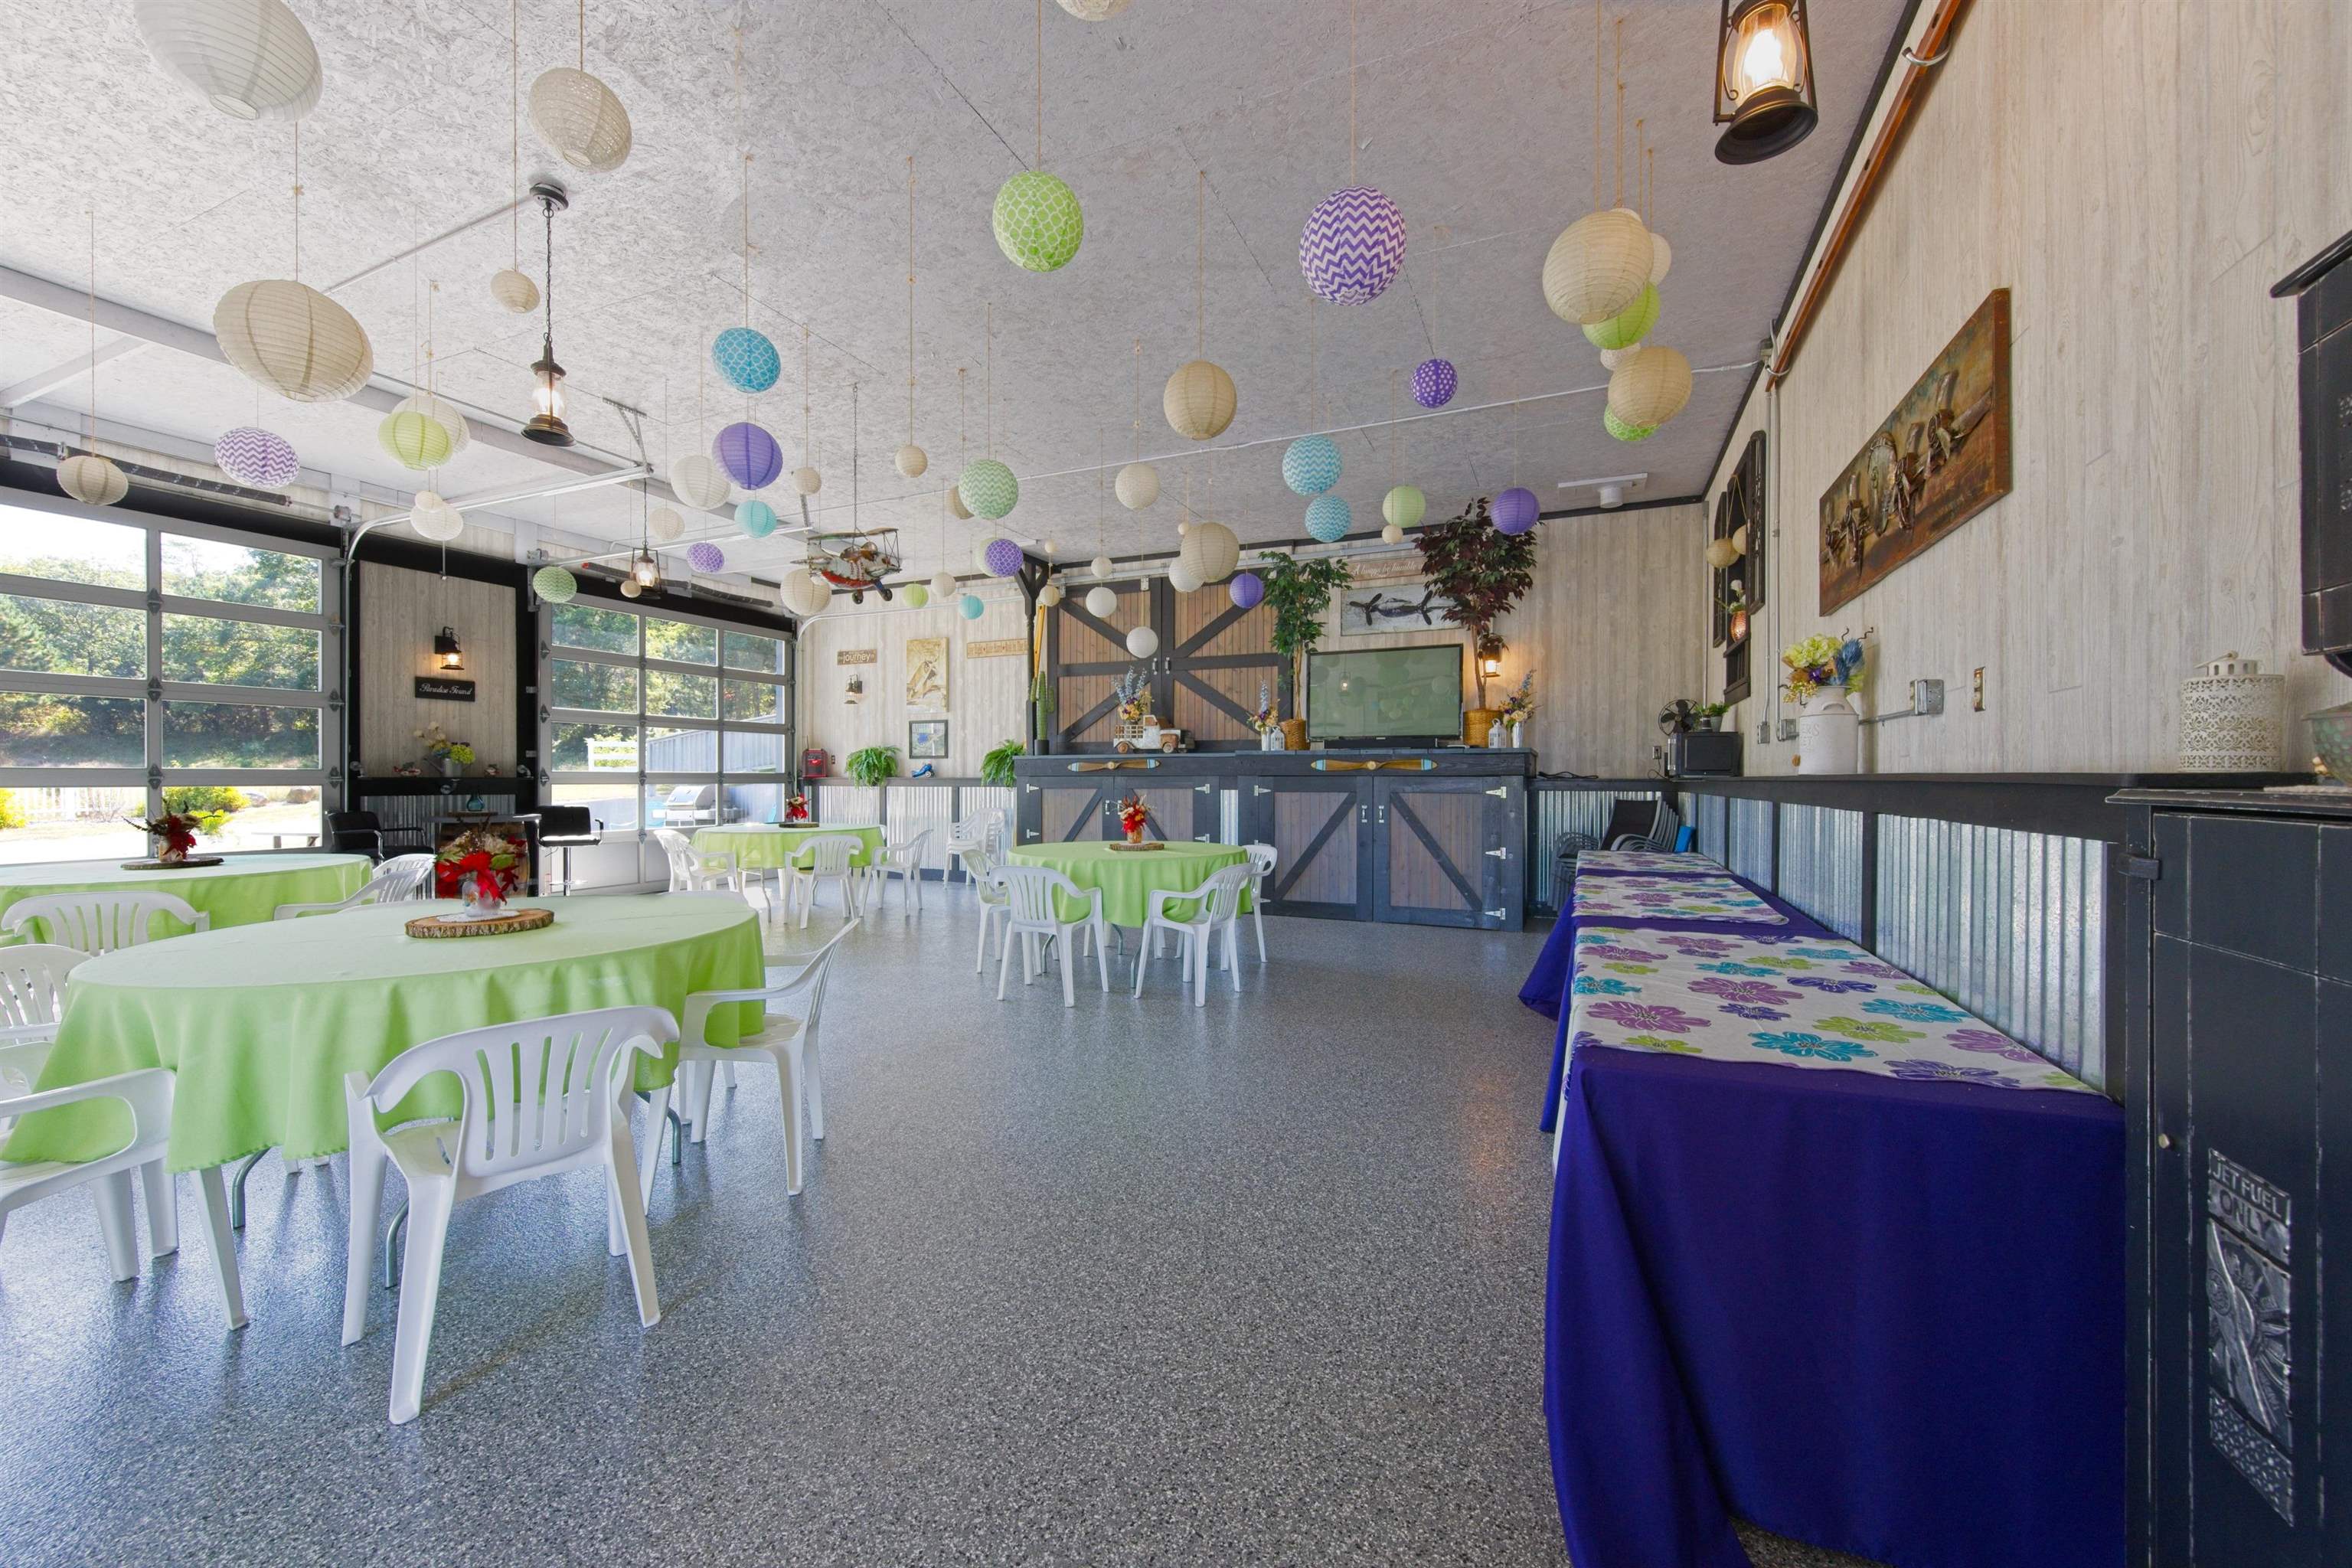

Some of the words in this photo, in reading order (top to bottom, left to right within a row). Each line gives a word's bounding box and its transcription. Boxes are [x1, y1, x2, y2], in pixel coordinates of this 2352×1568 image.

[1392, 561, 1417, 571] humble
[843, 652, 871, 664] journey
[420, 683, 449, 694] Paradise
[449, 685, 472, 695] Found
[2213, 1162, 2239, 1192] JET
[2241, 1177, 2282, 1219] FUEL
[2220, 1190, 2274, 1242] ONLY
